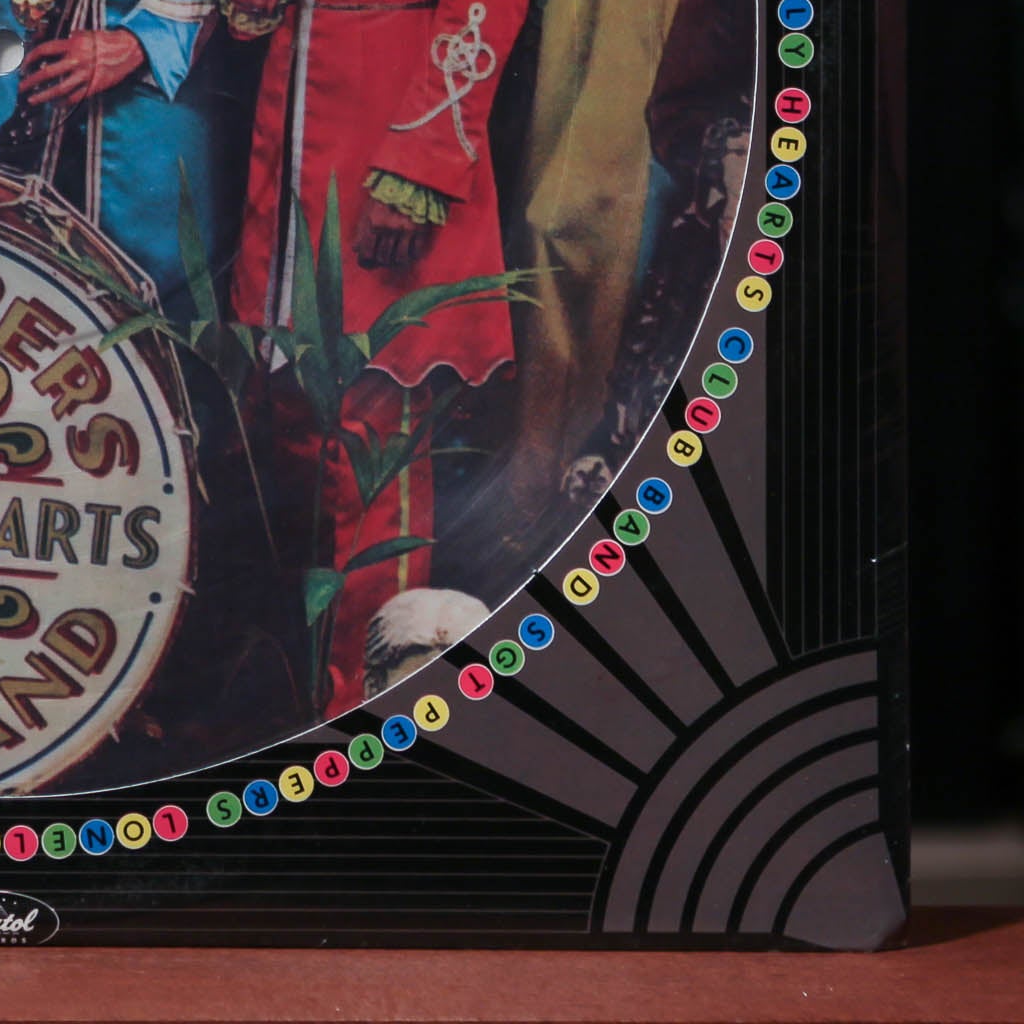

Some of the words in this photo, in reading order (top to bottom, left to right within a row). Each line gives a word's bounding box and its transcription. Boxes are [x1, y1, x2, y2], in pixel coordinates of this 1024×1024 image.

[742, 94, 804, 303] HEARTS
[672, 334, 747, 459] CLUB
[568, 484, 667, 599] BAND
[467, 621, 547, 693] SGT
[215, 700, 442, 822] PEPPERS
